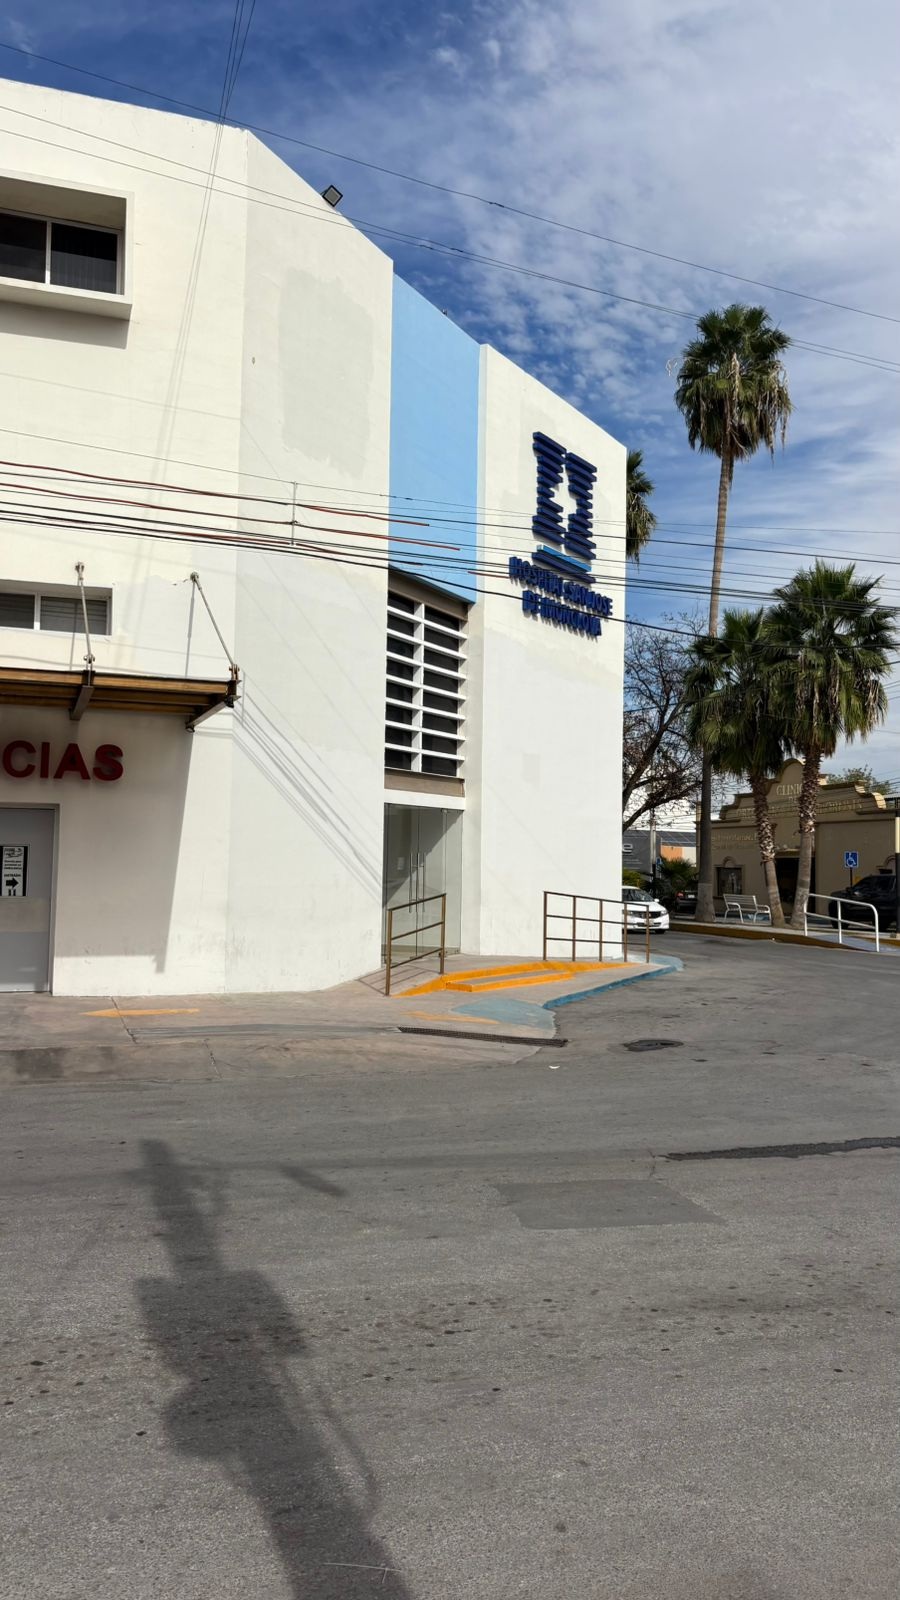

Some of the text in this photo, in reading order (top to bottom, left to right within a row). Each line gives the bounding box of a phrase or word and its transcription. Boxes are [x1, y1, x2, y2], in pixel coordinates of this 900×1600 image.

[509, 556, 563, 597] HOSPITAL
[563, 581, 588, 606] SAN
[522, 590, 542, 614] DE
[2, 740, 124, 781] CIAS
